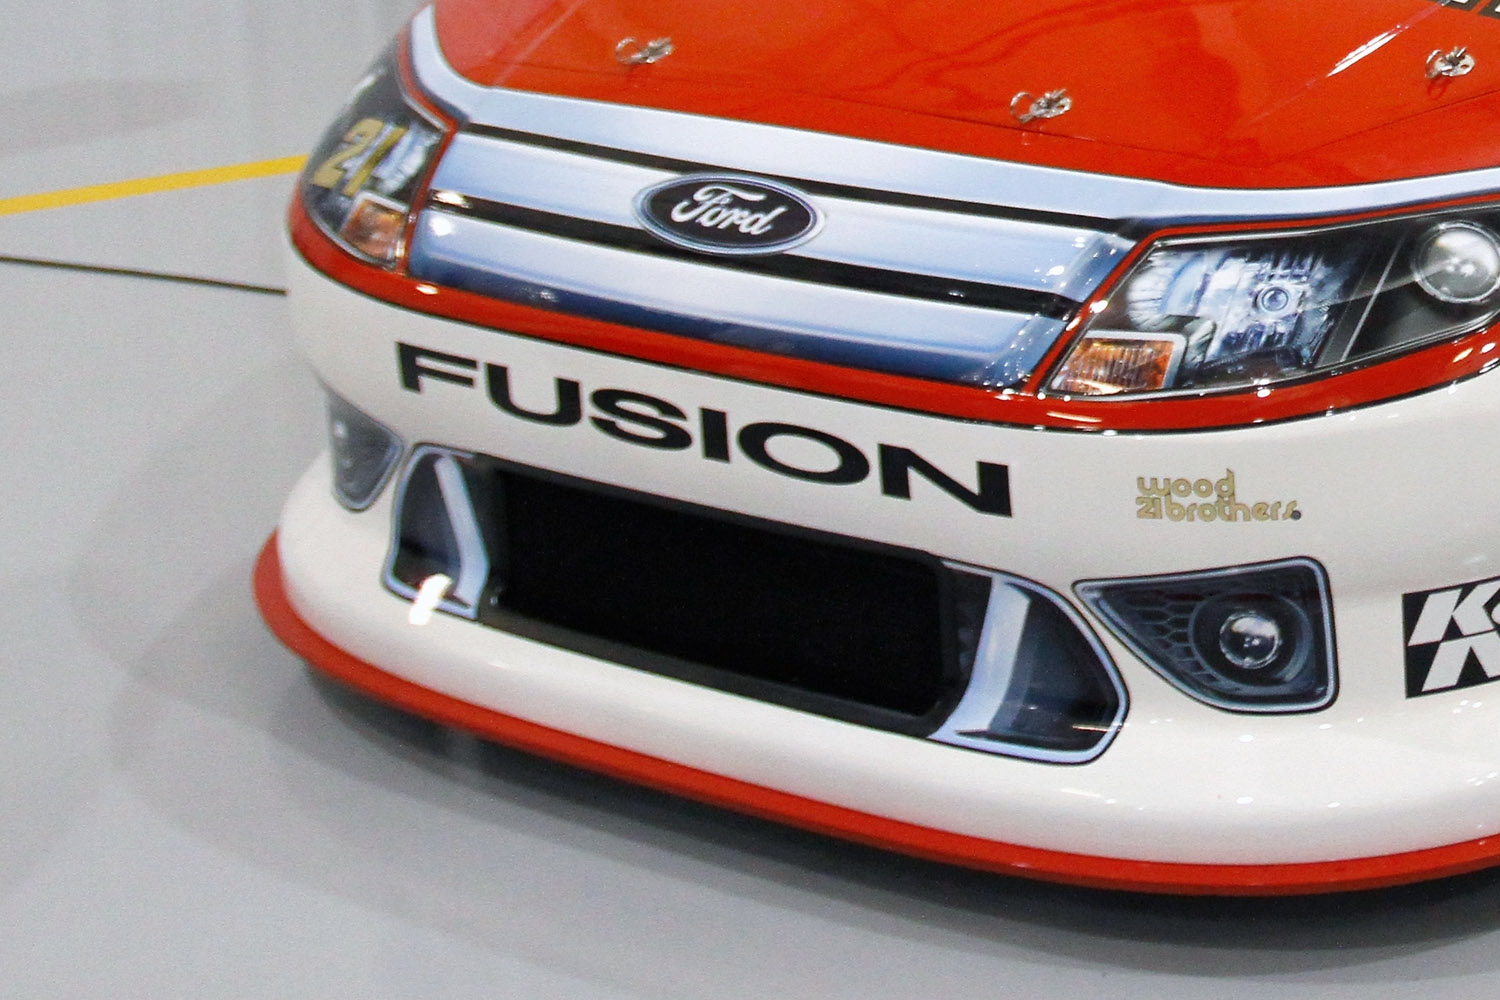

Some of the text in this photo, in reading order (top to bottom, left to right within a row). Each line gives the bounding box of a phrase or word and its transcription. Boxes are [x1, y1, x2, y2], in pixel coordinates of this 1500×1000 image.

[311, 118, 406, 195] 21
[670, 184, 786, 237] Ford
[395, 341, 1012, 518] FUSION
[1137, 468, 1235, 497] wood
